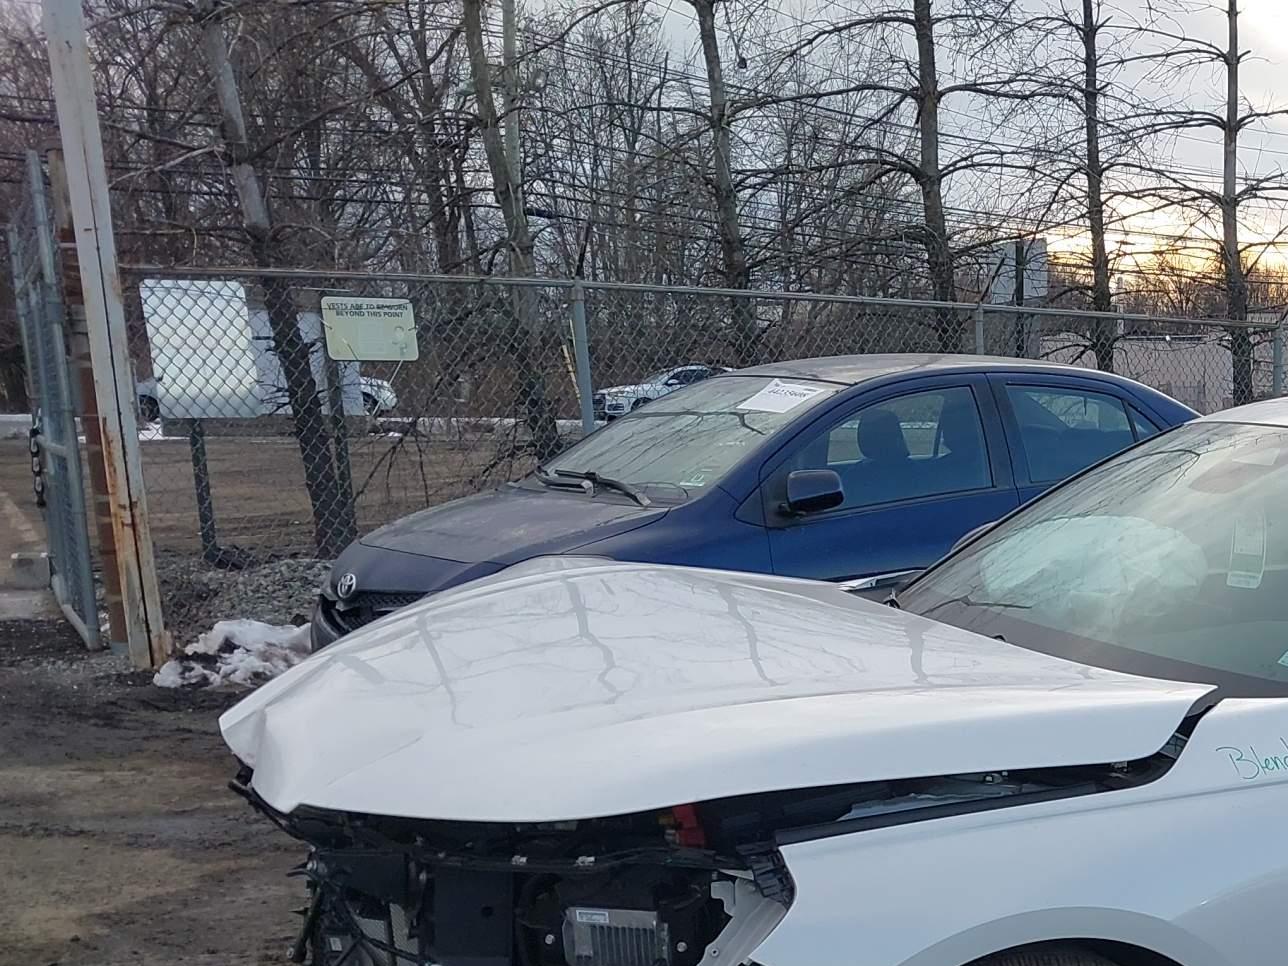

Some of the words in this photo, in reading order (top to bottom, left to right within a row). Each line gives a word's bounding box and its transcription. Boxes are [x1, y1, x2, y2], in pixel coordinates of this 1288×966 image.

[327, 303, 349, 311] VESTS
[350, 303, 364, 311] ARE
[366, 303, 376, 311] TO
[336, 310, 365, 318] BEYOND
[383, 311, 404, 319] POINT
